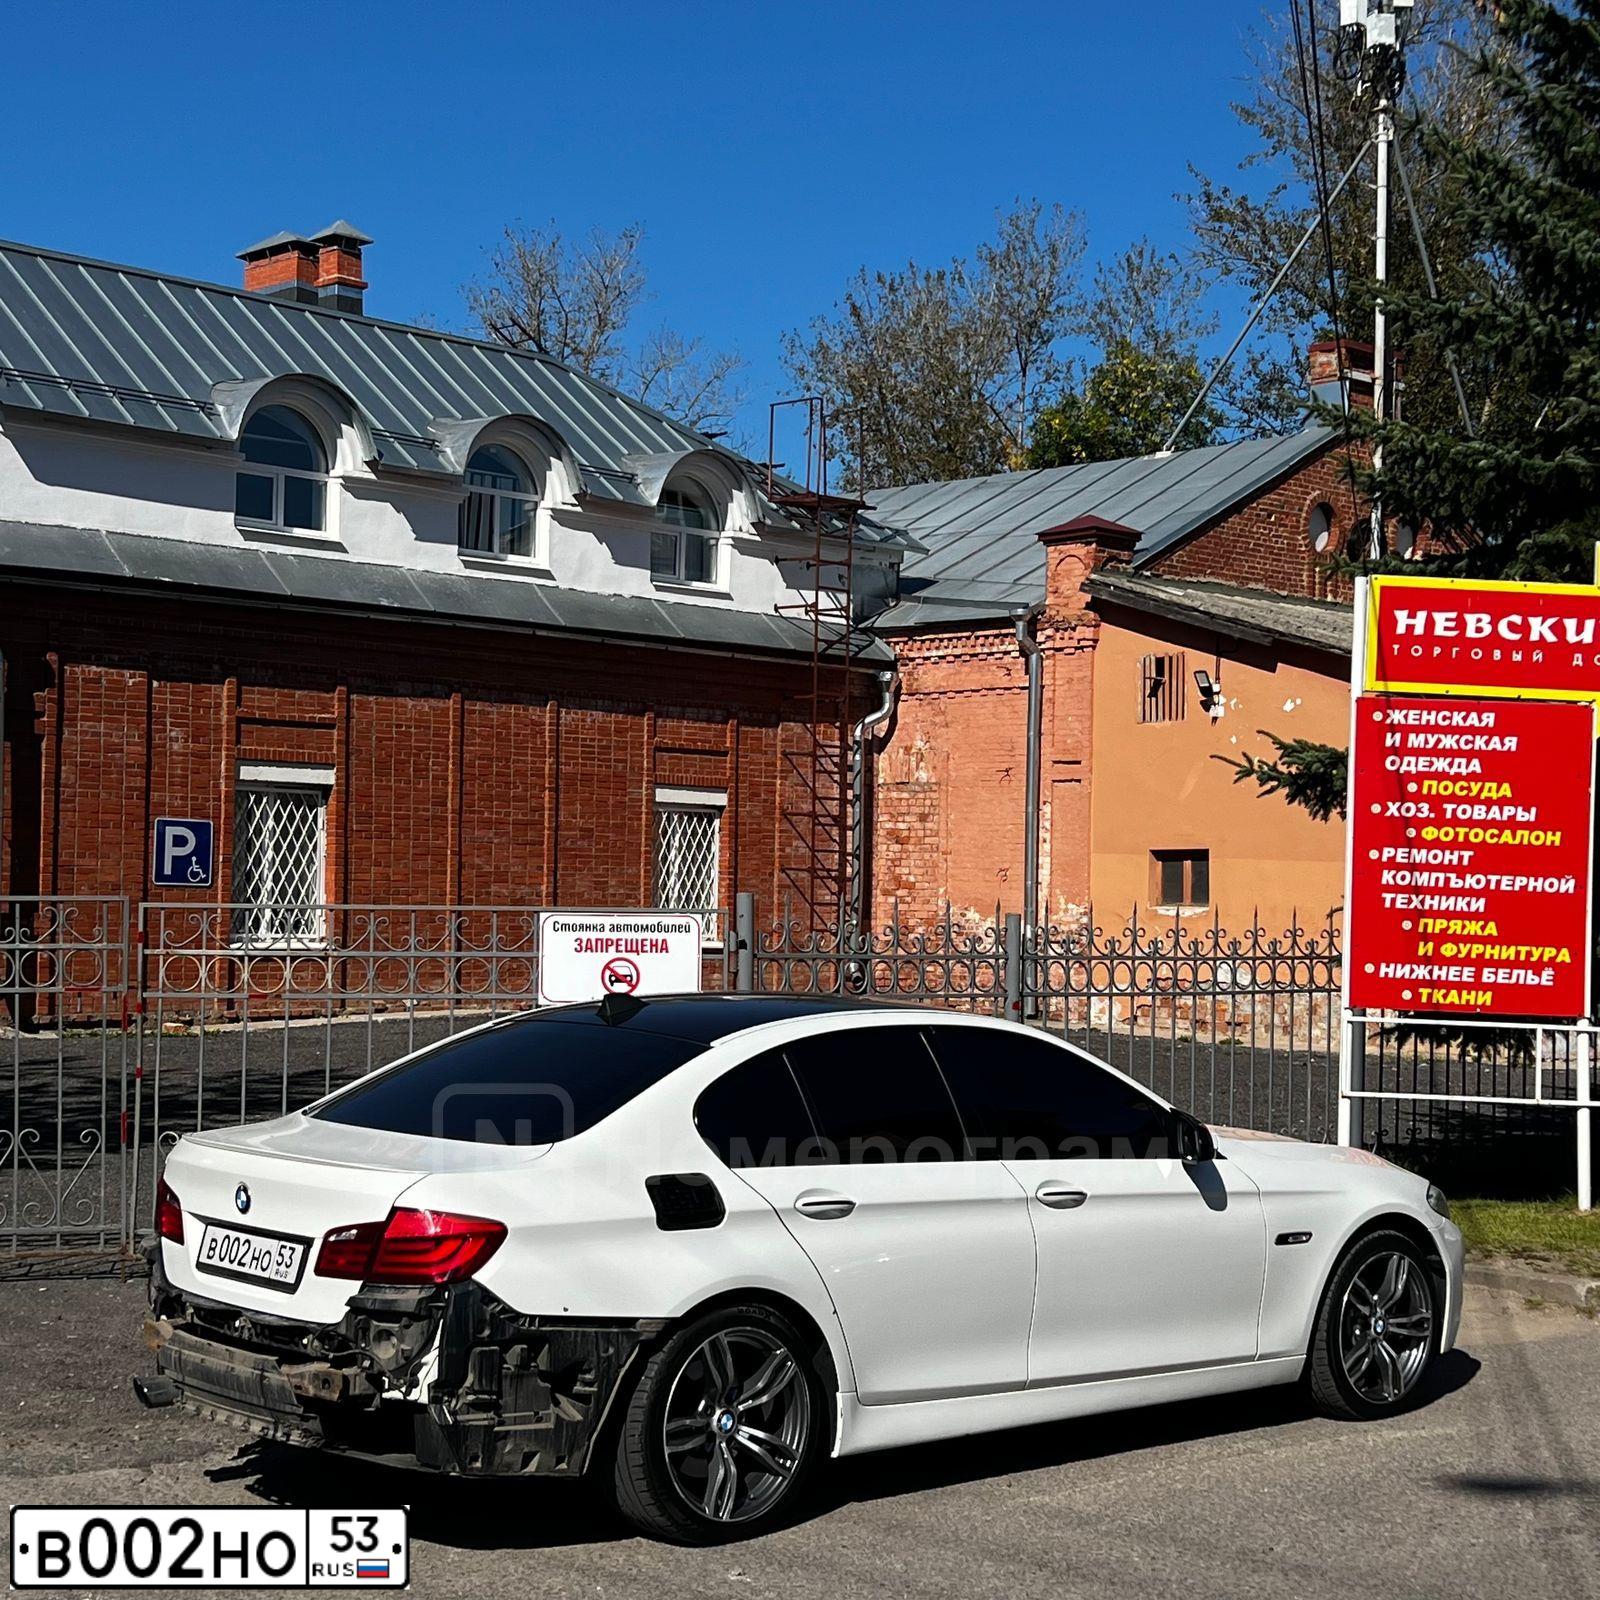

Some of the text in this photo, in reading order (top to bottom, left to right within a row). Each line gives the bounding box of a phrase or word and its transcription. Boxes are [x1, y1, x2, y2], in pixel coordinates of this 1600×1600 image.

[1393, 610, 1600, 644] НЕВСКИ
[1393, 645, 1542, 662] ТОРГОВЫЙ
[1385, 709, 1495, 727] ЖЕНСКАЯ
[1385, 733, 1517, 751] И МУЖСКАЯ
[1385, 755, 1481, 775] ОДЕЖДА
[1422, 780, 1512, 800] ПОСУДА
[1385, 802, 1536, 821] ХОЗ. ТОВАРЫ
[1421, 826, 1561, 846] ФОТОСАЛОН
[164, 826, 197, 877] P
[1382, 847, 1474, 865] РЕМОНТ
[1382, 870, 1575, 894] КОМПЪЮТЕРНОЙ
[1382, 893, 1485, 912] ТЕХНИКИ
[553, 921, 690, 933] Стоянка автомобилей
[1418, 918, 1498, 936] ПРЯЖА
[575, 938, 669, 955] ЗАПРЕЩЕНА
[1418, 942, 1571, 963] И ФУРНИТУРА
[1380, 963, 1554, 985] НИЖНЕЕ БЕЛЬЁ
[1419, 988, 1492, 1005] ТКАНИ
[206, 1234, 296, 1272] В002НО 53
